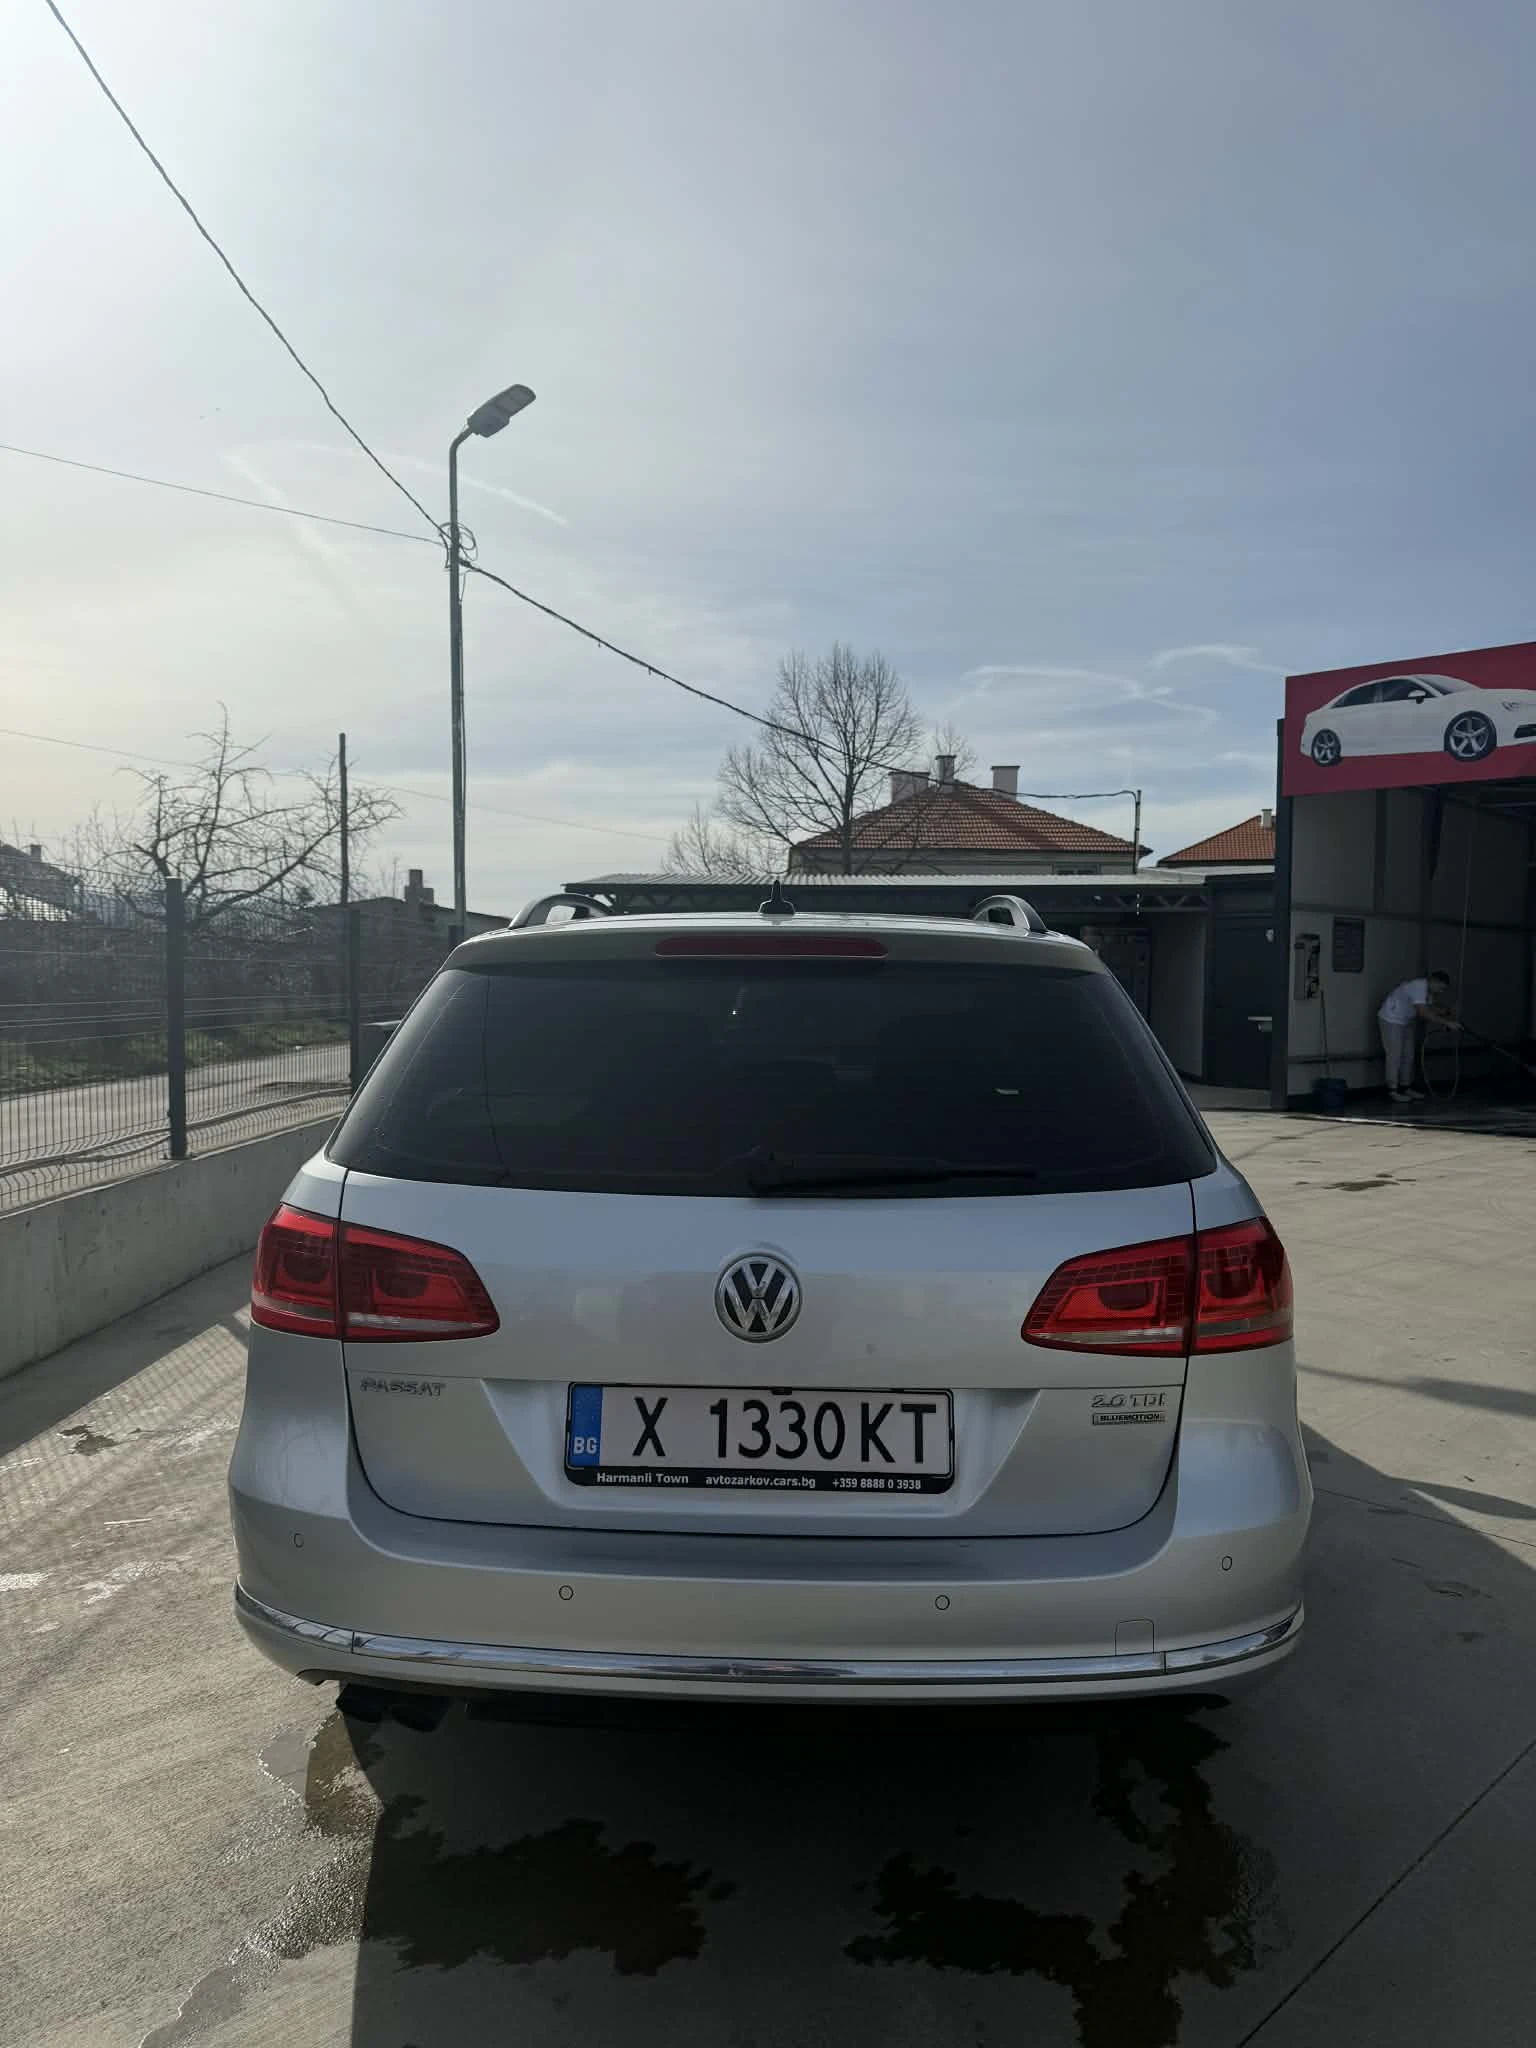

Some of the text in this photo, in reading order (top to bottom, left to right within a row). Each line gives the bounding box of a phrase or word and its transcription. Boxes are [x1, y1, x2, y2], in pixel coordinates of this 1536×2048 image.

[717, 1256, 800, 1338] VW
[360, 1377, 446, 1397] PASSAT
[1100, 1413, 1160, 1422] BLUEMOTION
[631, 1397, 937, 1465] X 1330 KT
[573, 1436, 598, 1455] BG
[596, 1472, 921, 1490] Harmanli Town avtozarkov.cars.bg +359 8888 0 3938
